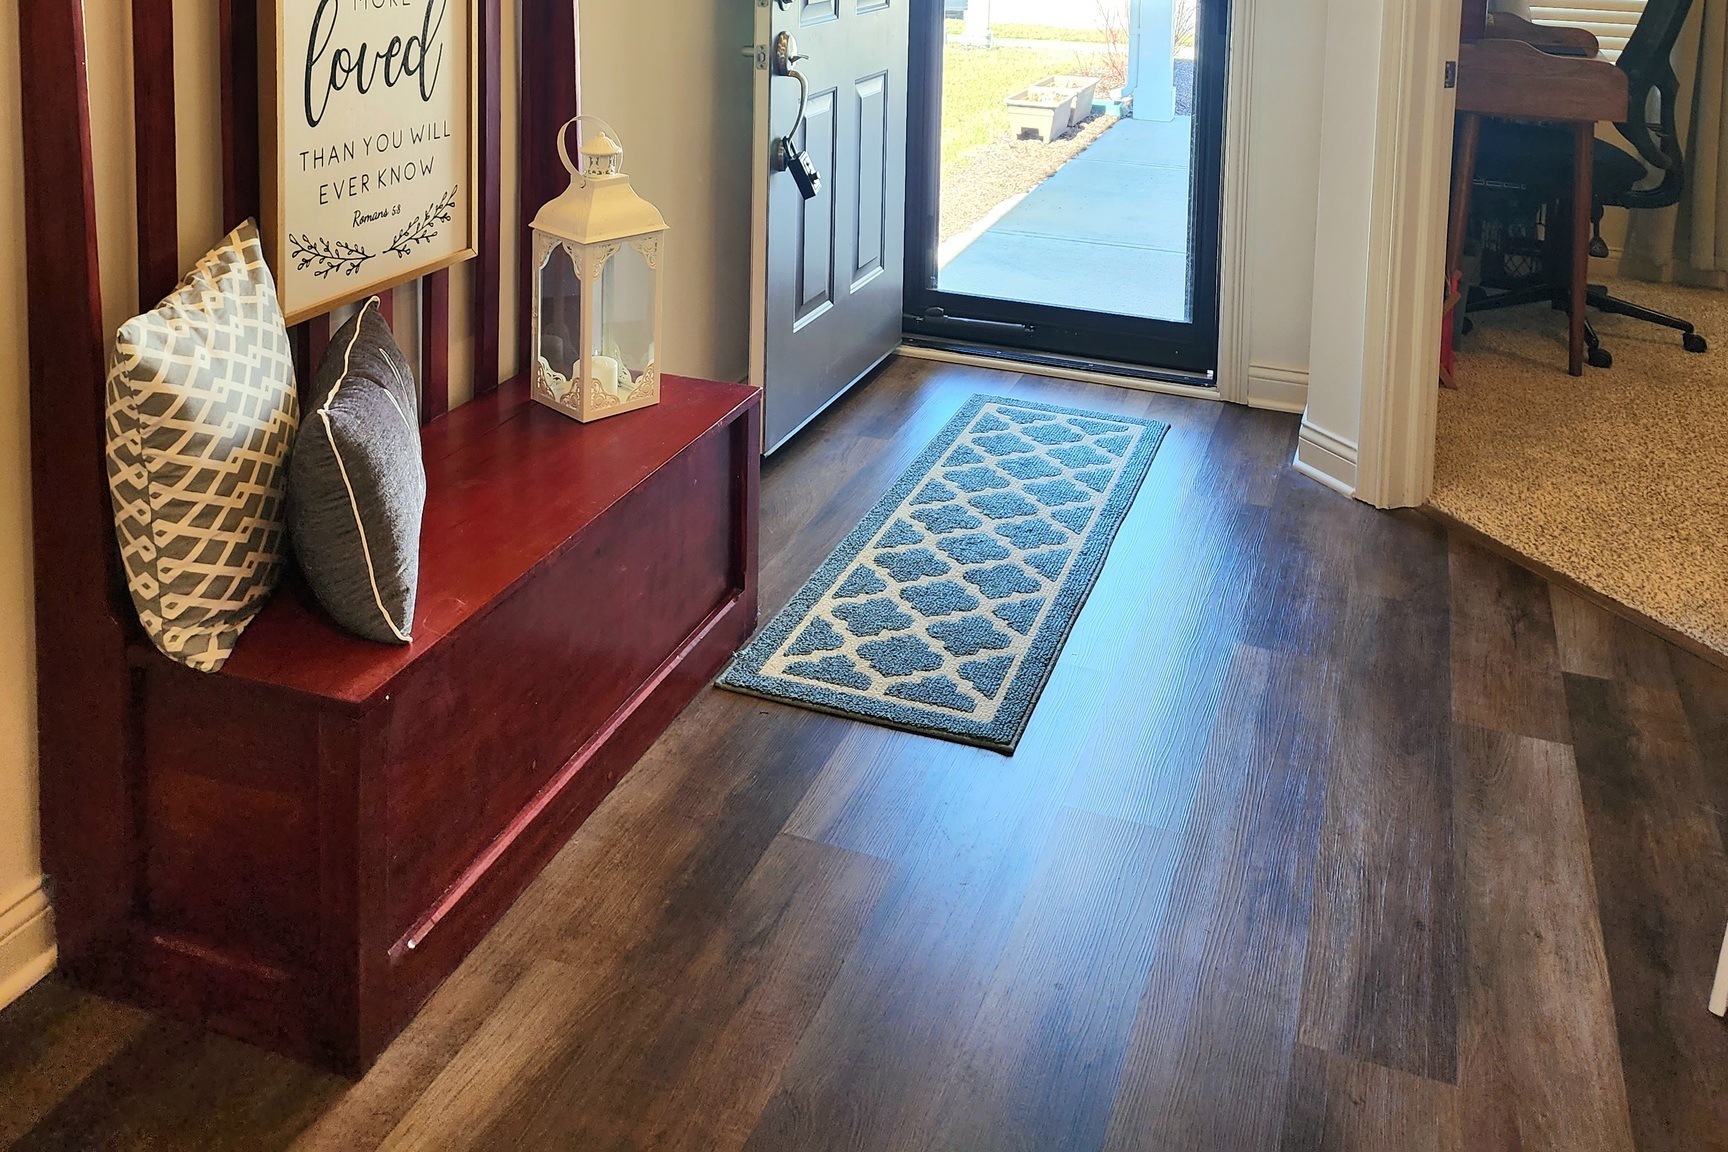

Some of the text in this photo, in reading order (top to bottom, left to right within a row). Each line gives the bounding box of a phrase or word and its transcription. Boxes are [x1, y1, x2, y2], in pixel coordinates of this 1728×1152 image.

[299, 120, 451, 172] THAN YOU WILL
[319, 155, 435, 206] EVER KNOW
[352, 208, 389, 228] Romans
